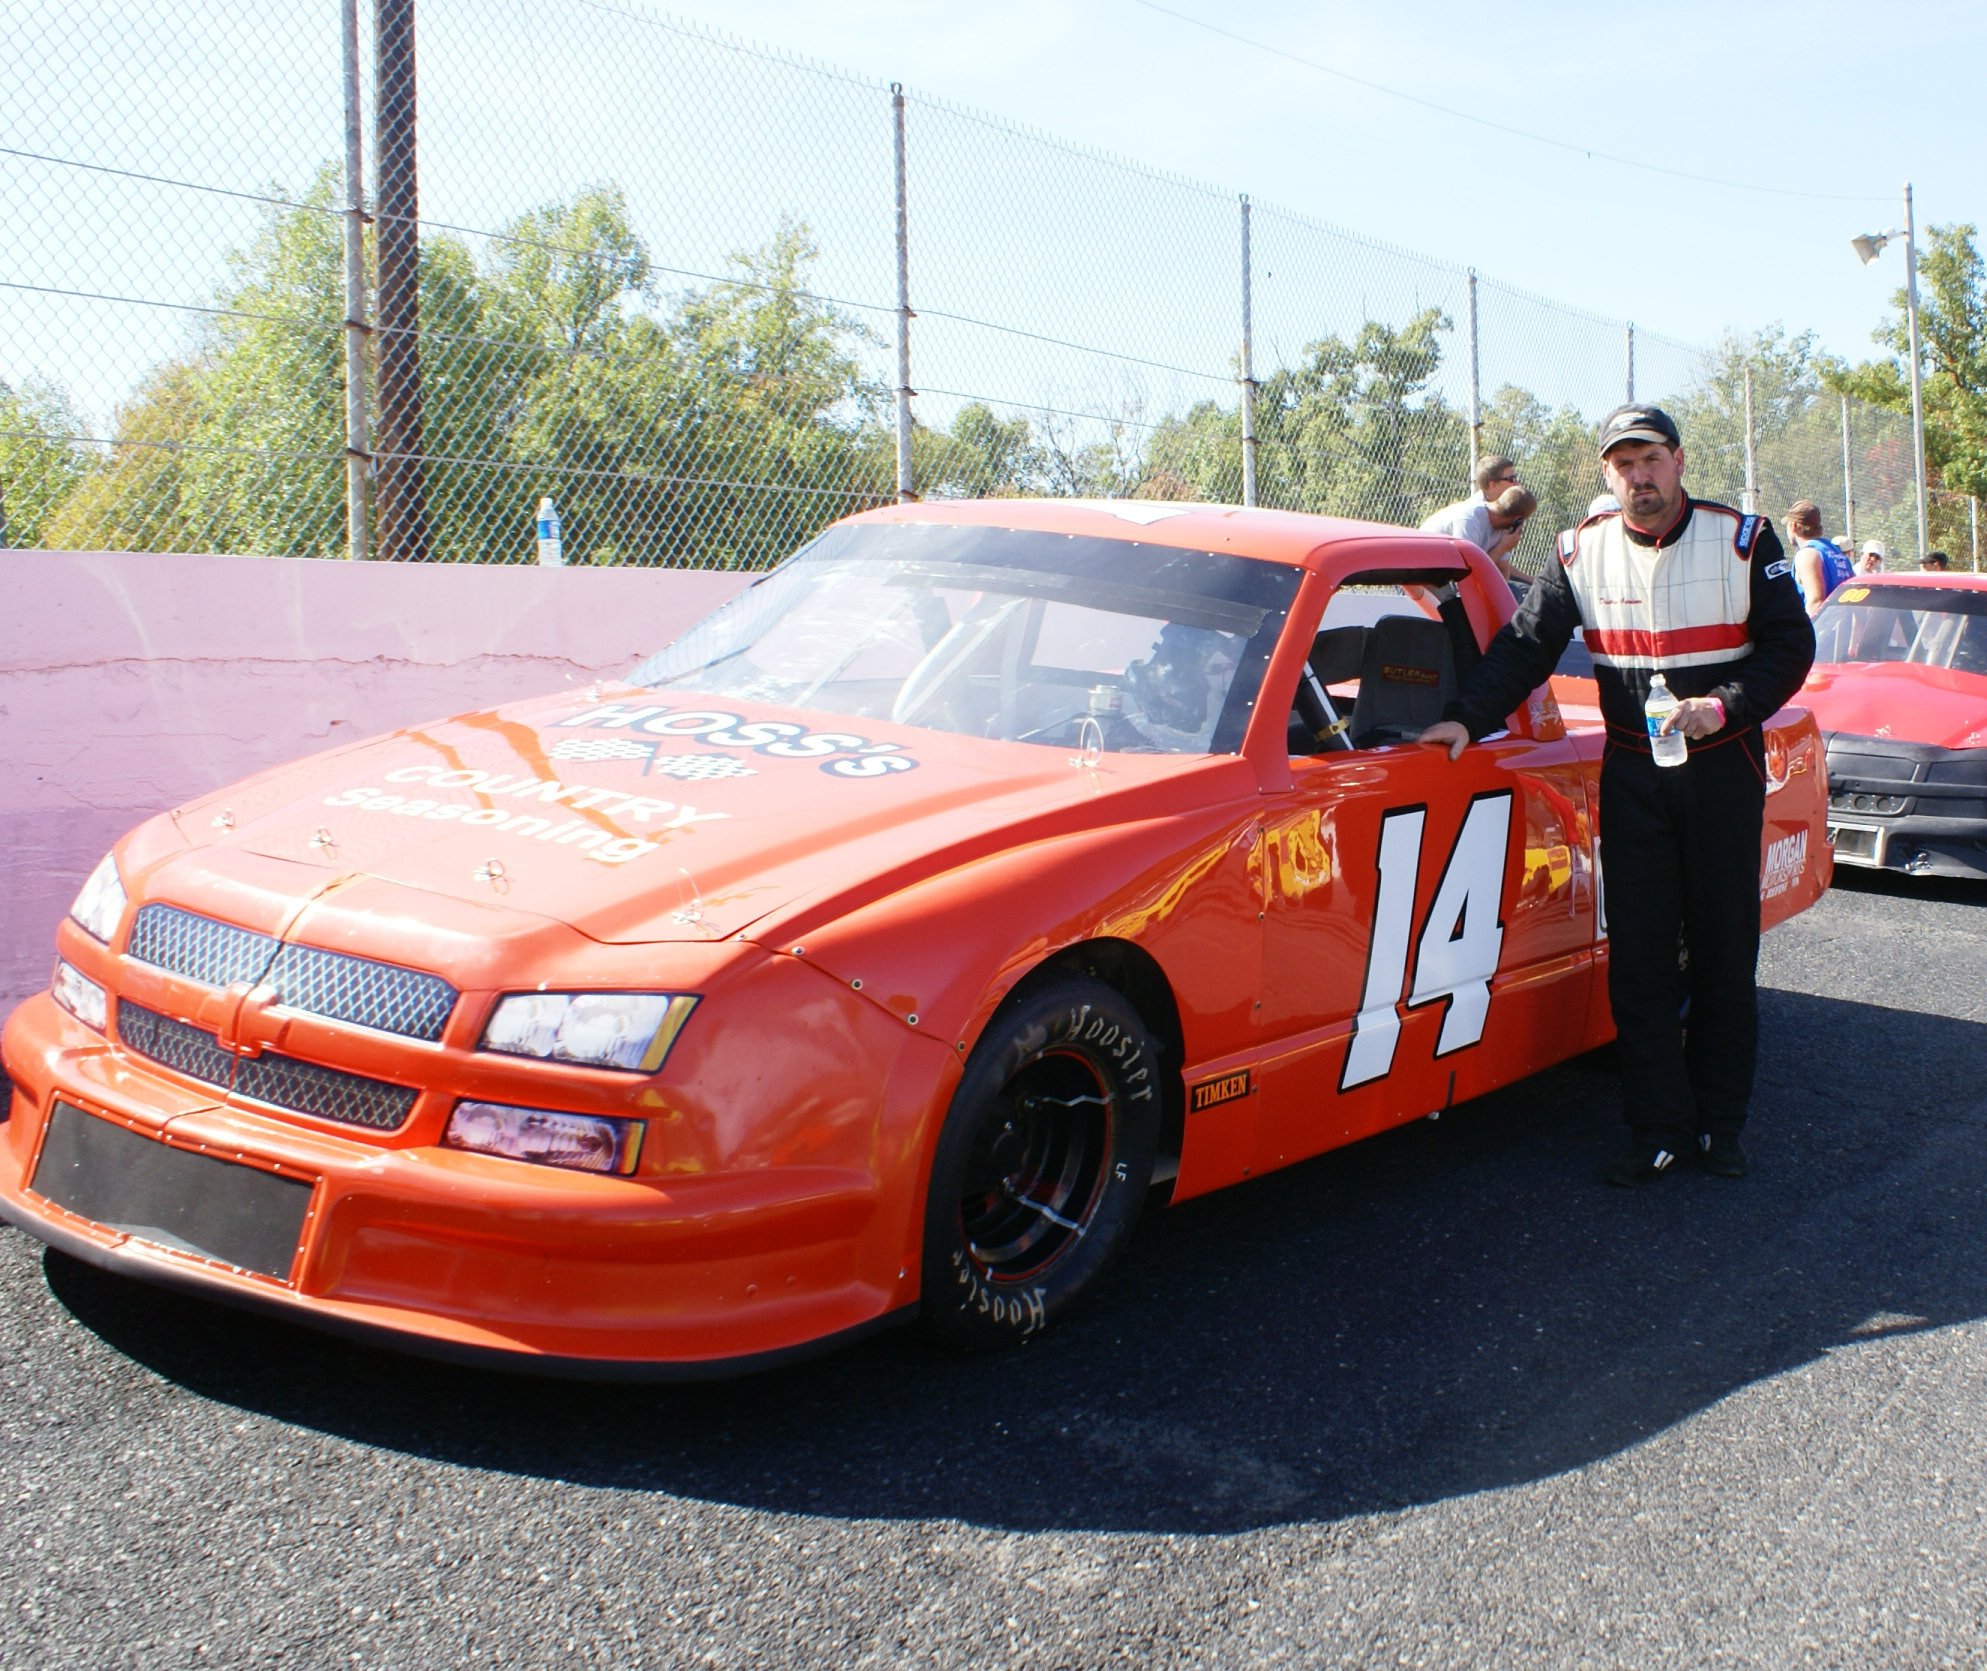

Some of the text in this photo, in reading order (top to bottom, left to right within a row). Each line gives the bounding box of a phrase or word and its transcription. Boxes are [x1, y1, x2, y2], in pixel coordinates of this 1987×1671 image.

[1838, 588, 1870, 602] 00
[549, 704, 920, 778] HOSS'S
[323, 787, 660, 864] Seasoning
[383, 765, 732, 826] COUNTRY
[1765, 828, 1808, 874] MORGAN
[1337, 787, 1514, 1095] 14
[1196, 1073, 1247, 1108] TIMKEN
